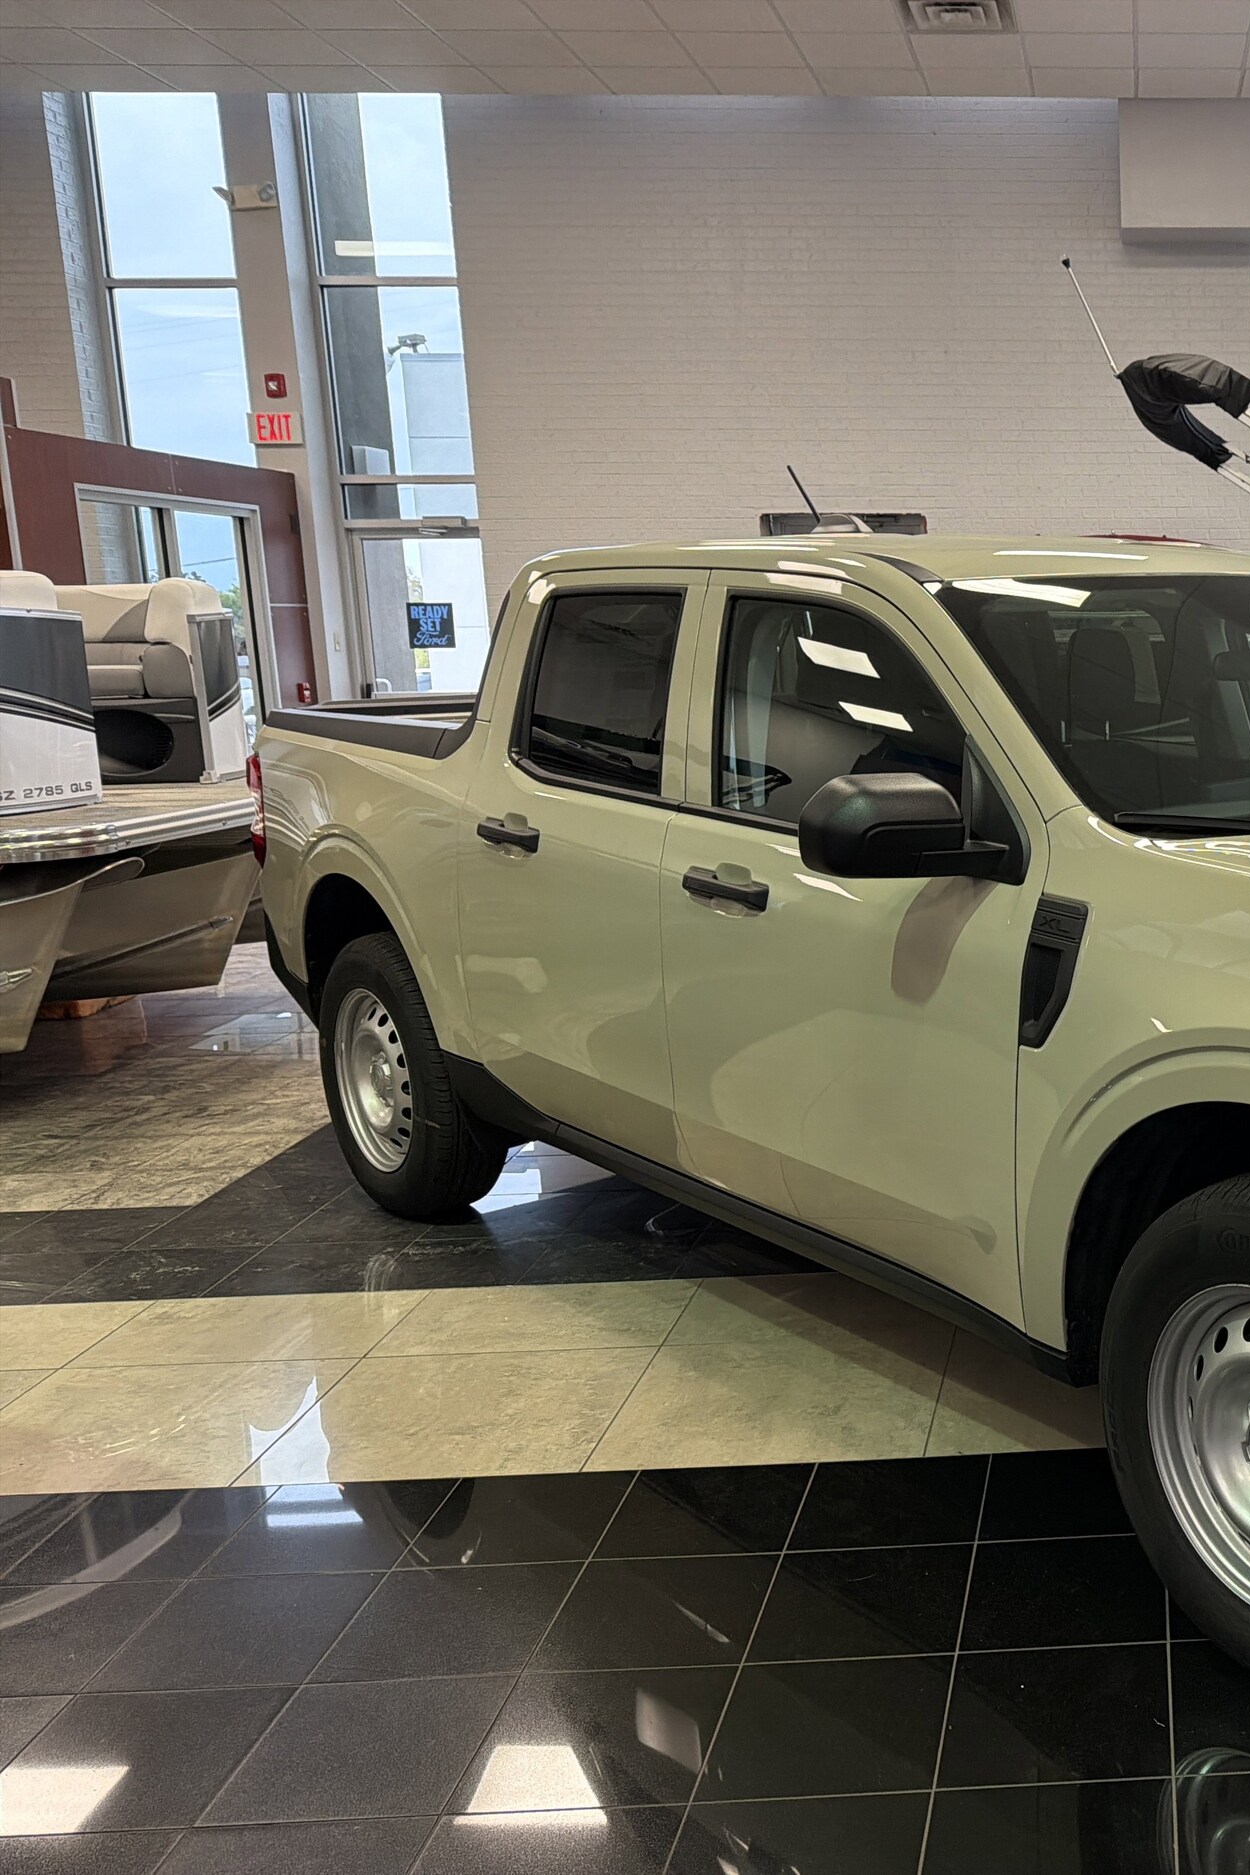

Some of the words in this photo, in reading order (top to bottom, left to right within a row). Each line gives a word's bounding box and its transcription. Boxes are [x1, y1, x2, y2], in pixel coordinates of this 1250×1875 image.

[255, 413, 292, 442] EXIT
[409, 605, 449, 619] READY
[419, 618, 441, 632] SET
[413, 631, 451, 646] Ford
[0, 790, 16, 802] Z
[22, 785, 64, 799] 2785
[69, 781, 93, 793] QLS
[1039, 915, 1071, 934] XL
